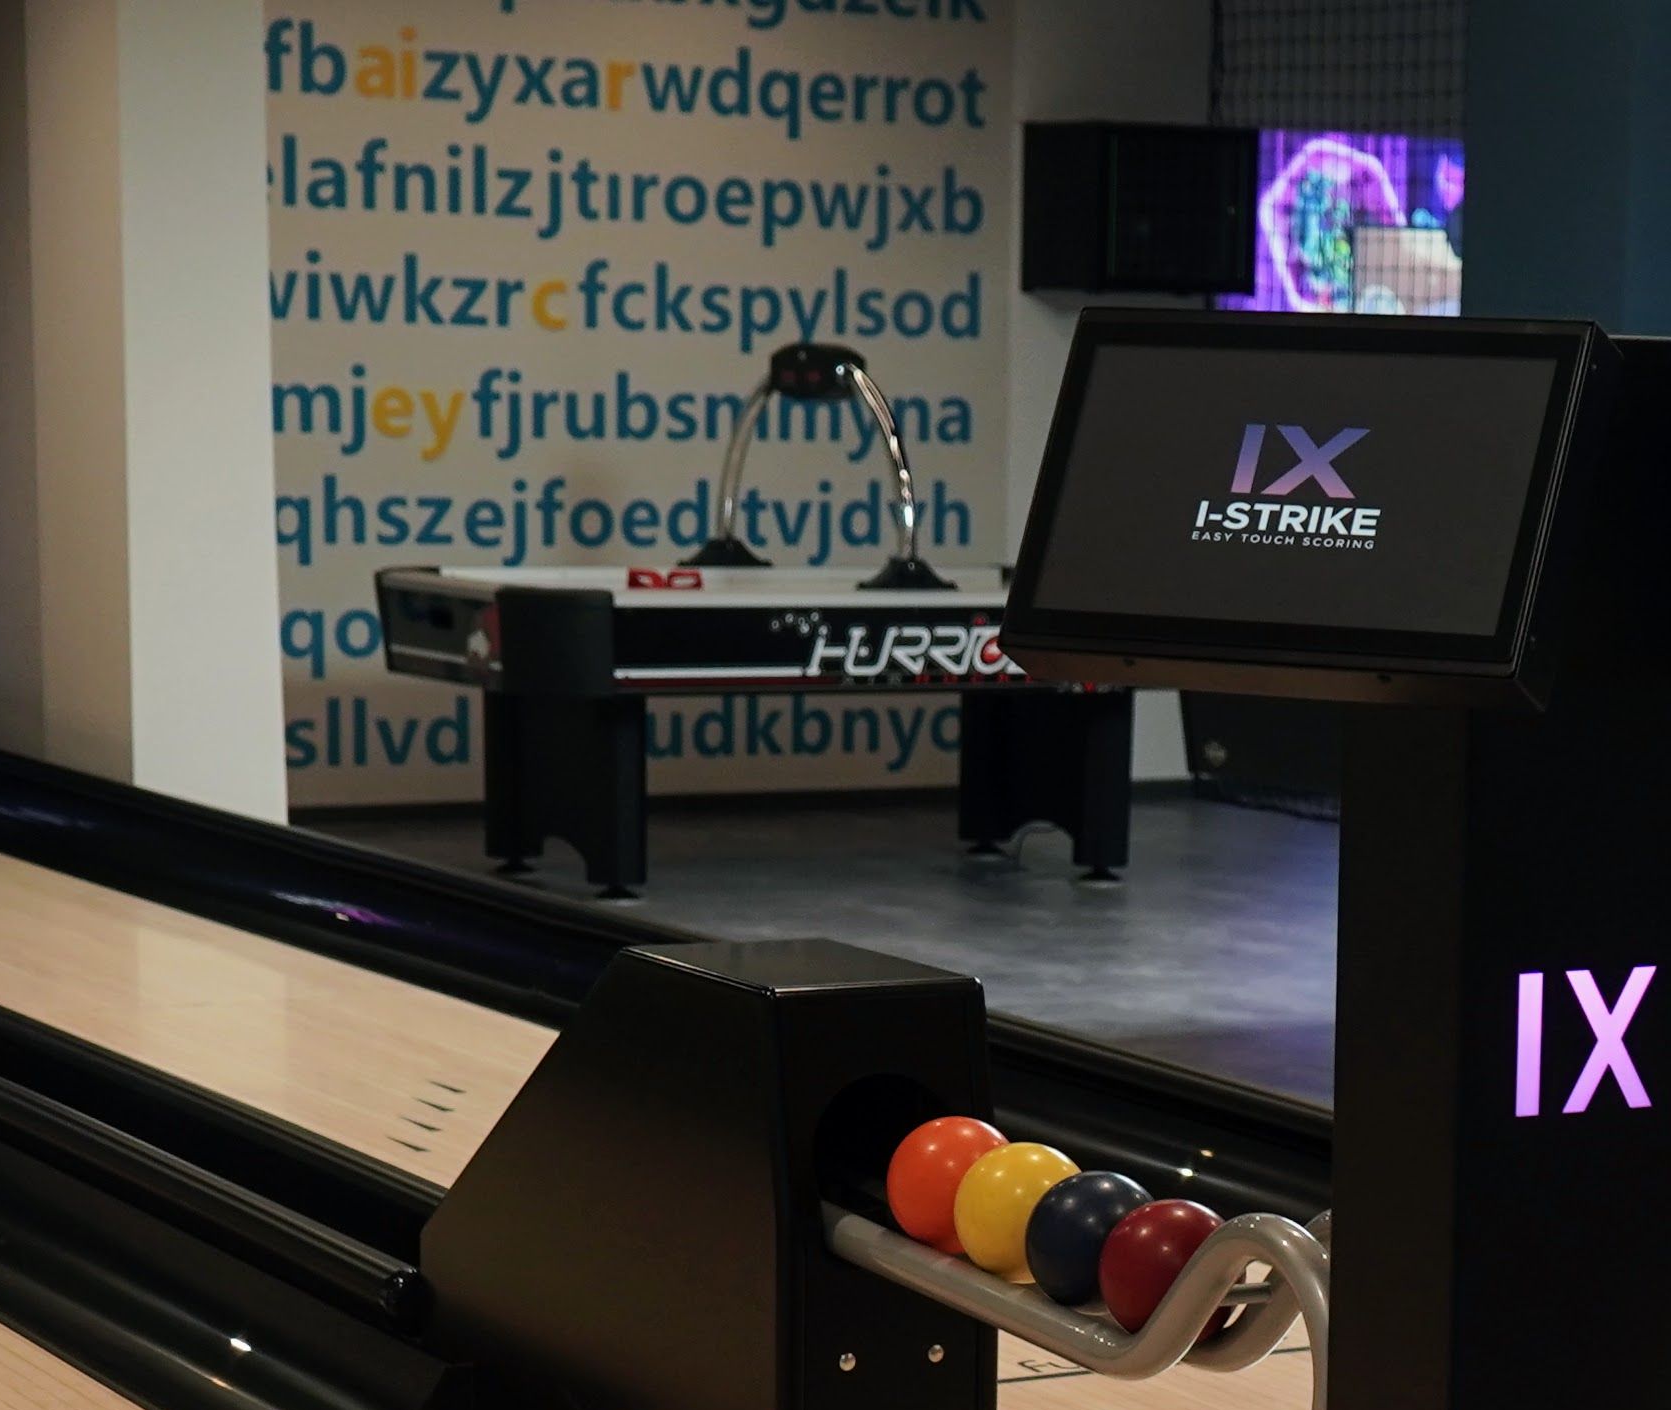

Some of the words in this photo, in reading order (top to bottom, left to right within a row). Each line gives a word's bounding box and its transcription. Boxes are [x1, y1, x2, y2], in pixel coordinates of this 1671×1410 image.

[1231, 424, 1371, 499] IX
[1191, 530, 1233, 542] EASY
[1241, 533, 1295, 545] TOUCH
[1302, 536, 1375, 550] SCORING
[1195, 500, 1381, 537] I-STRIKE
[805, 625, 1028, 677] HURRIC
[1515, 965, 1657, 1117] IX
